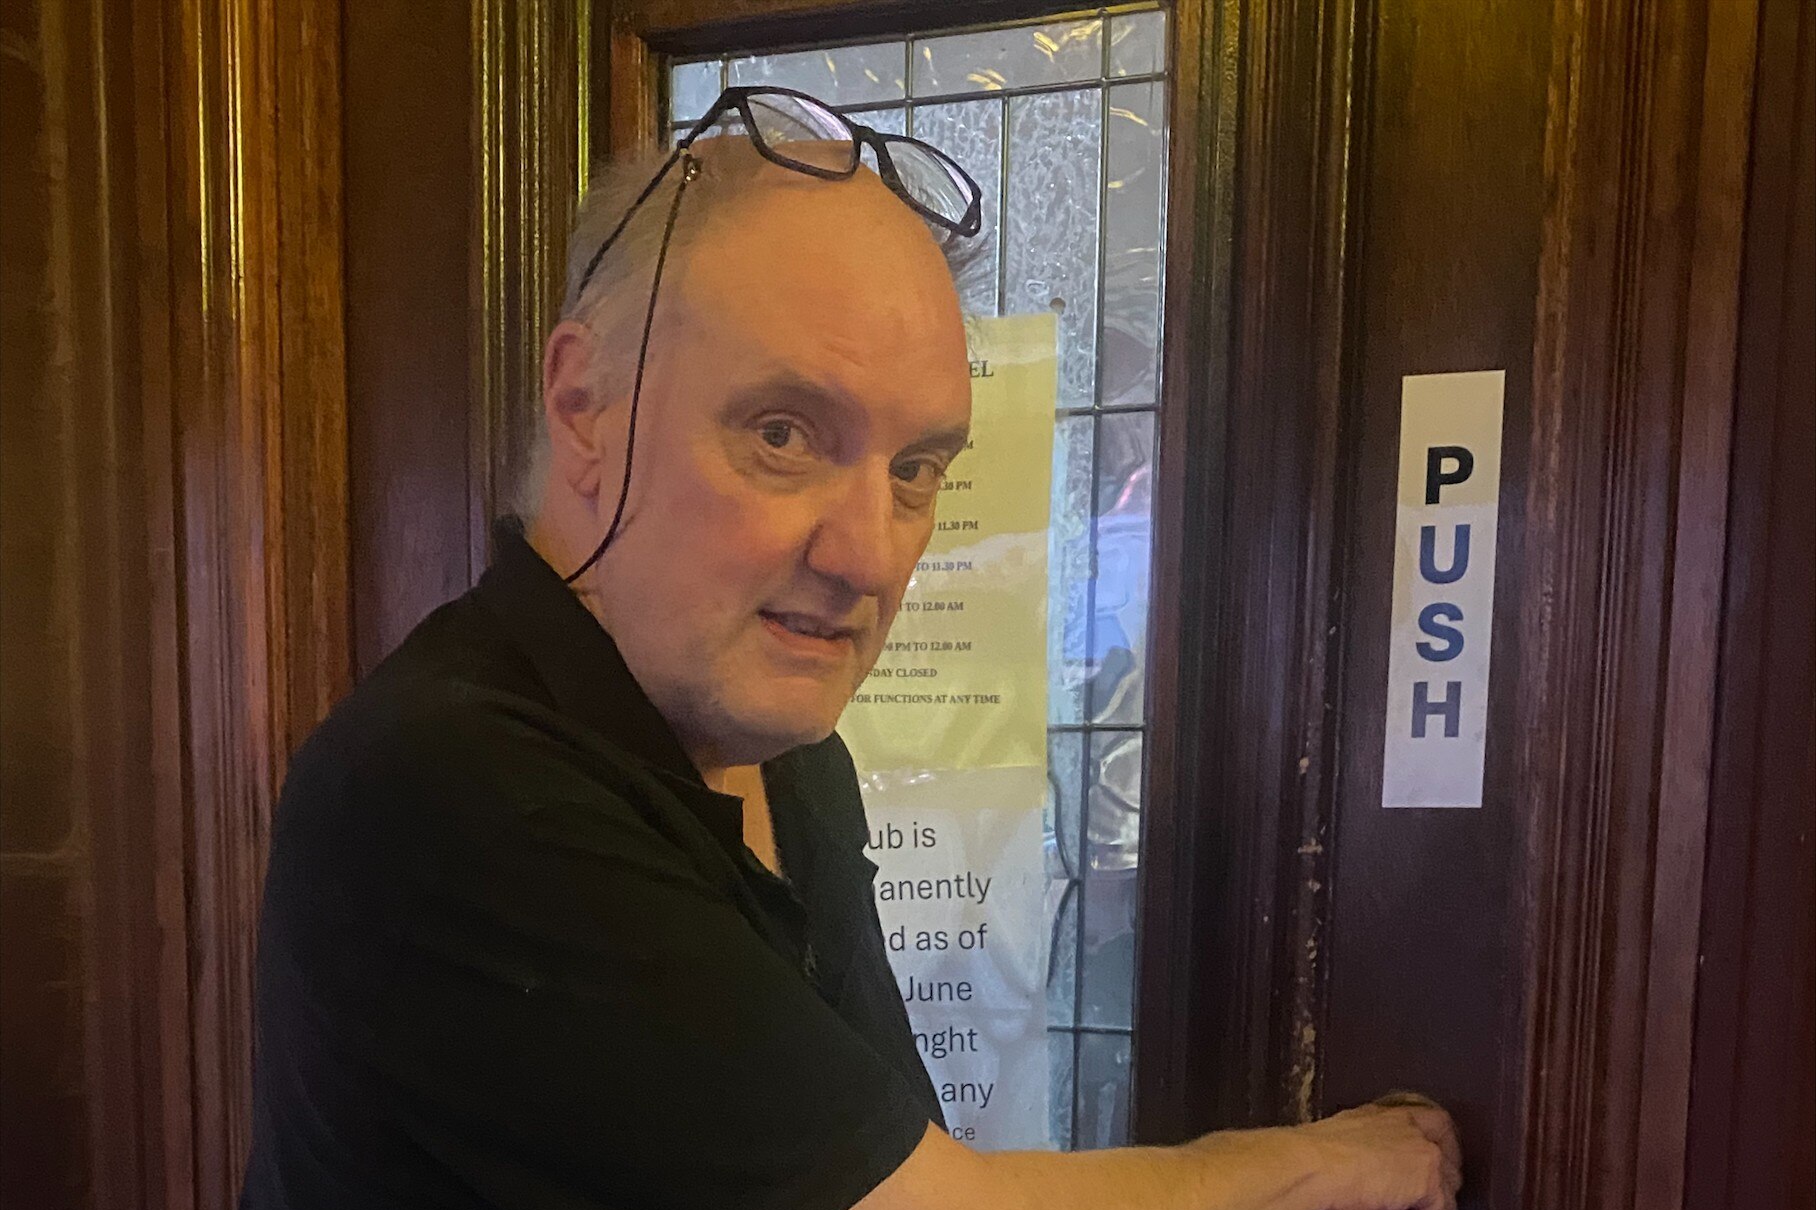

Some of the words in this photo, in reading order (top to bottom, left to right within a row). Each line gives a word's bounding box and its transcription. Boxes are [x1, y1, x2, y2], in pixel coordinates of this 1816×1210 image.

[956, 480, 972, 490] PM
[962, 520, 978, 530] PM
[957, 561, 972, 571] PM
[1410, 446, 1474, 738] PUSH
[905, 602, 919, 611] TO
[947, 601, 964, 611] AM
[895, 642, 911, 651] PM
[913, 642, 928, 651] TO
[955, 641, 972, 651] AM
[895, 668, 938, 677] CLOSED
[874, 694, 933, 704] FUNCTIONS
[934, 694, 948, 704] AT
[950, 694, 971, 704] ANY
[973, 694, 1001, 704] TIME
[913, 821, 937, 849] is
[872, 871, 992, 904] anently
[887, 925, 905, 951] d
[915, 931, 949, 951] as
[958, 922, 989, 951] of
[905, 976, 973, 1003] June
[941, 1082, 995, 1109] any
